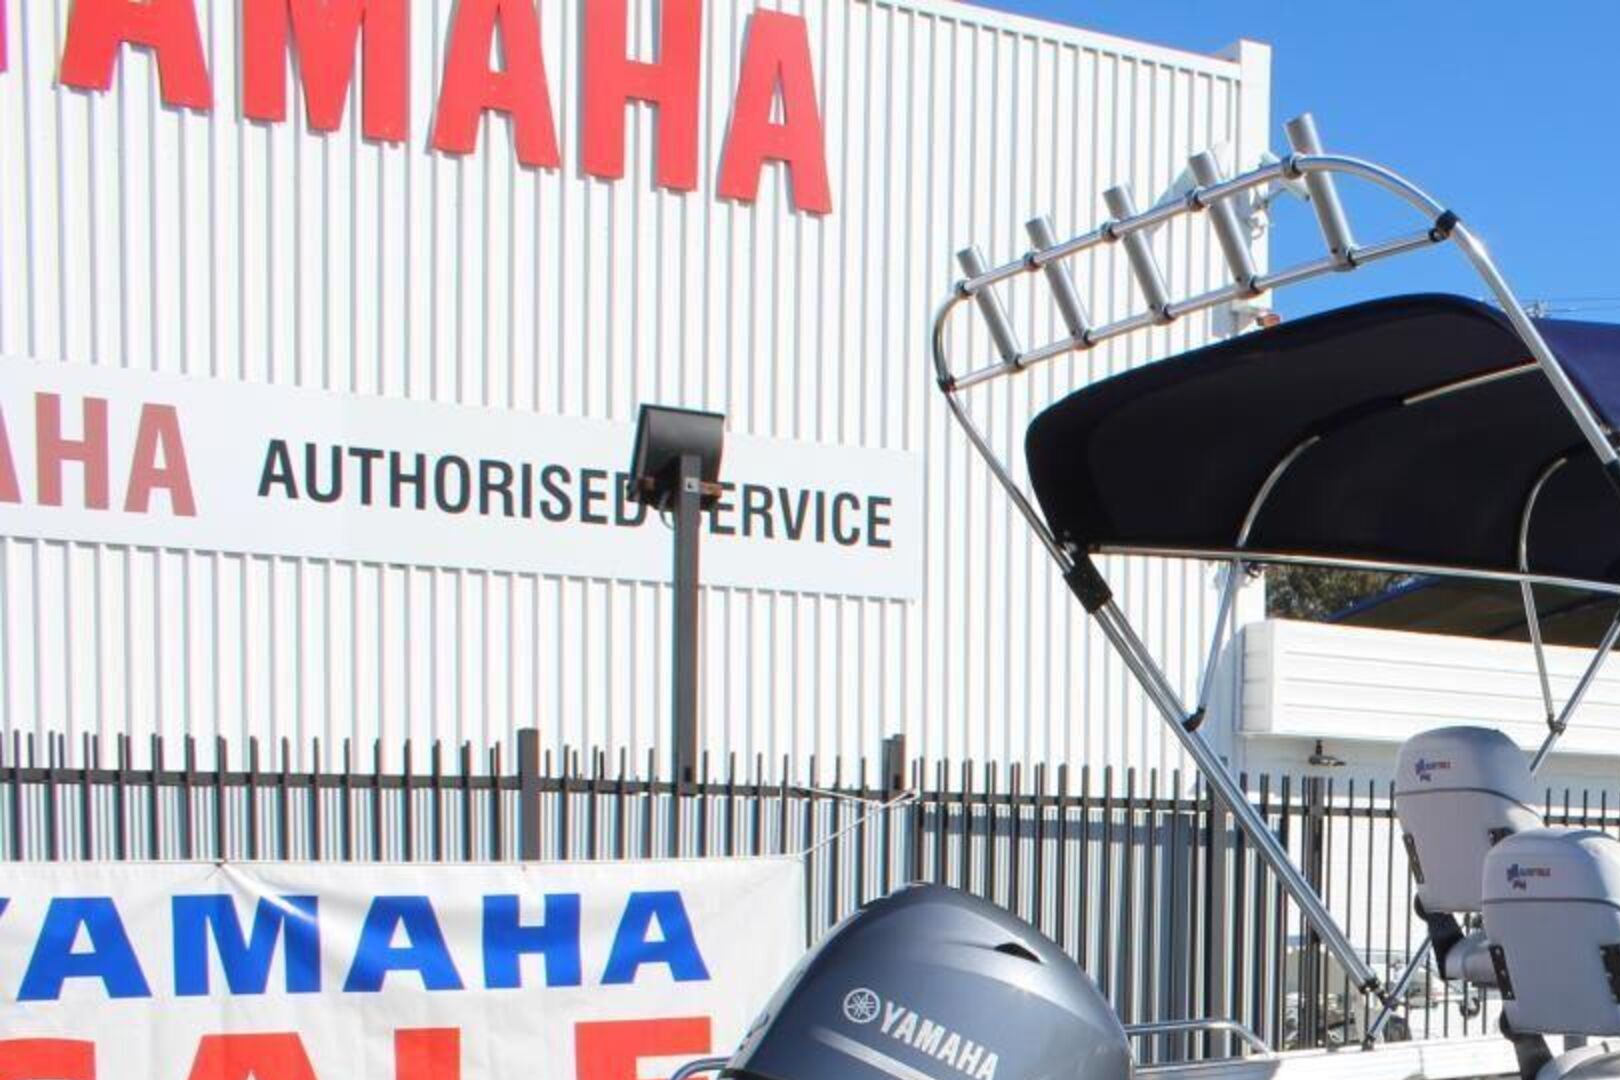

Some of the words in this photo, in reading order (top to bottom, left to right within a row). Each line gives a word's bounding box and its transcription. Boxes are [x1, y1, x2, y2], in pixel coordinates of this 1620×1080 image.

[258, 439, 647, 527] AUTHORISED
[709, 481, 893, 549] ERVICE
[0, 890, 711, 1001] AMAHA
